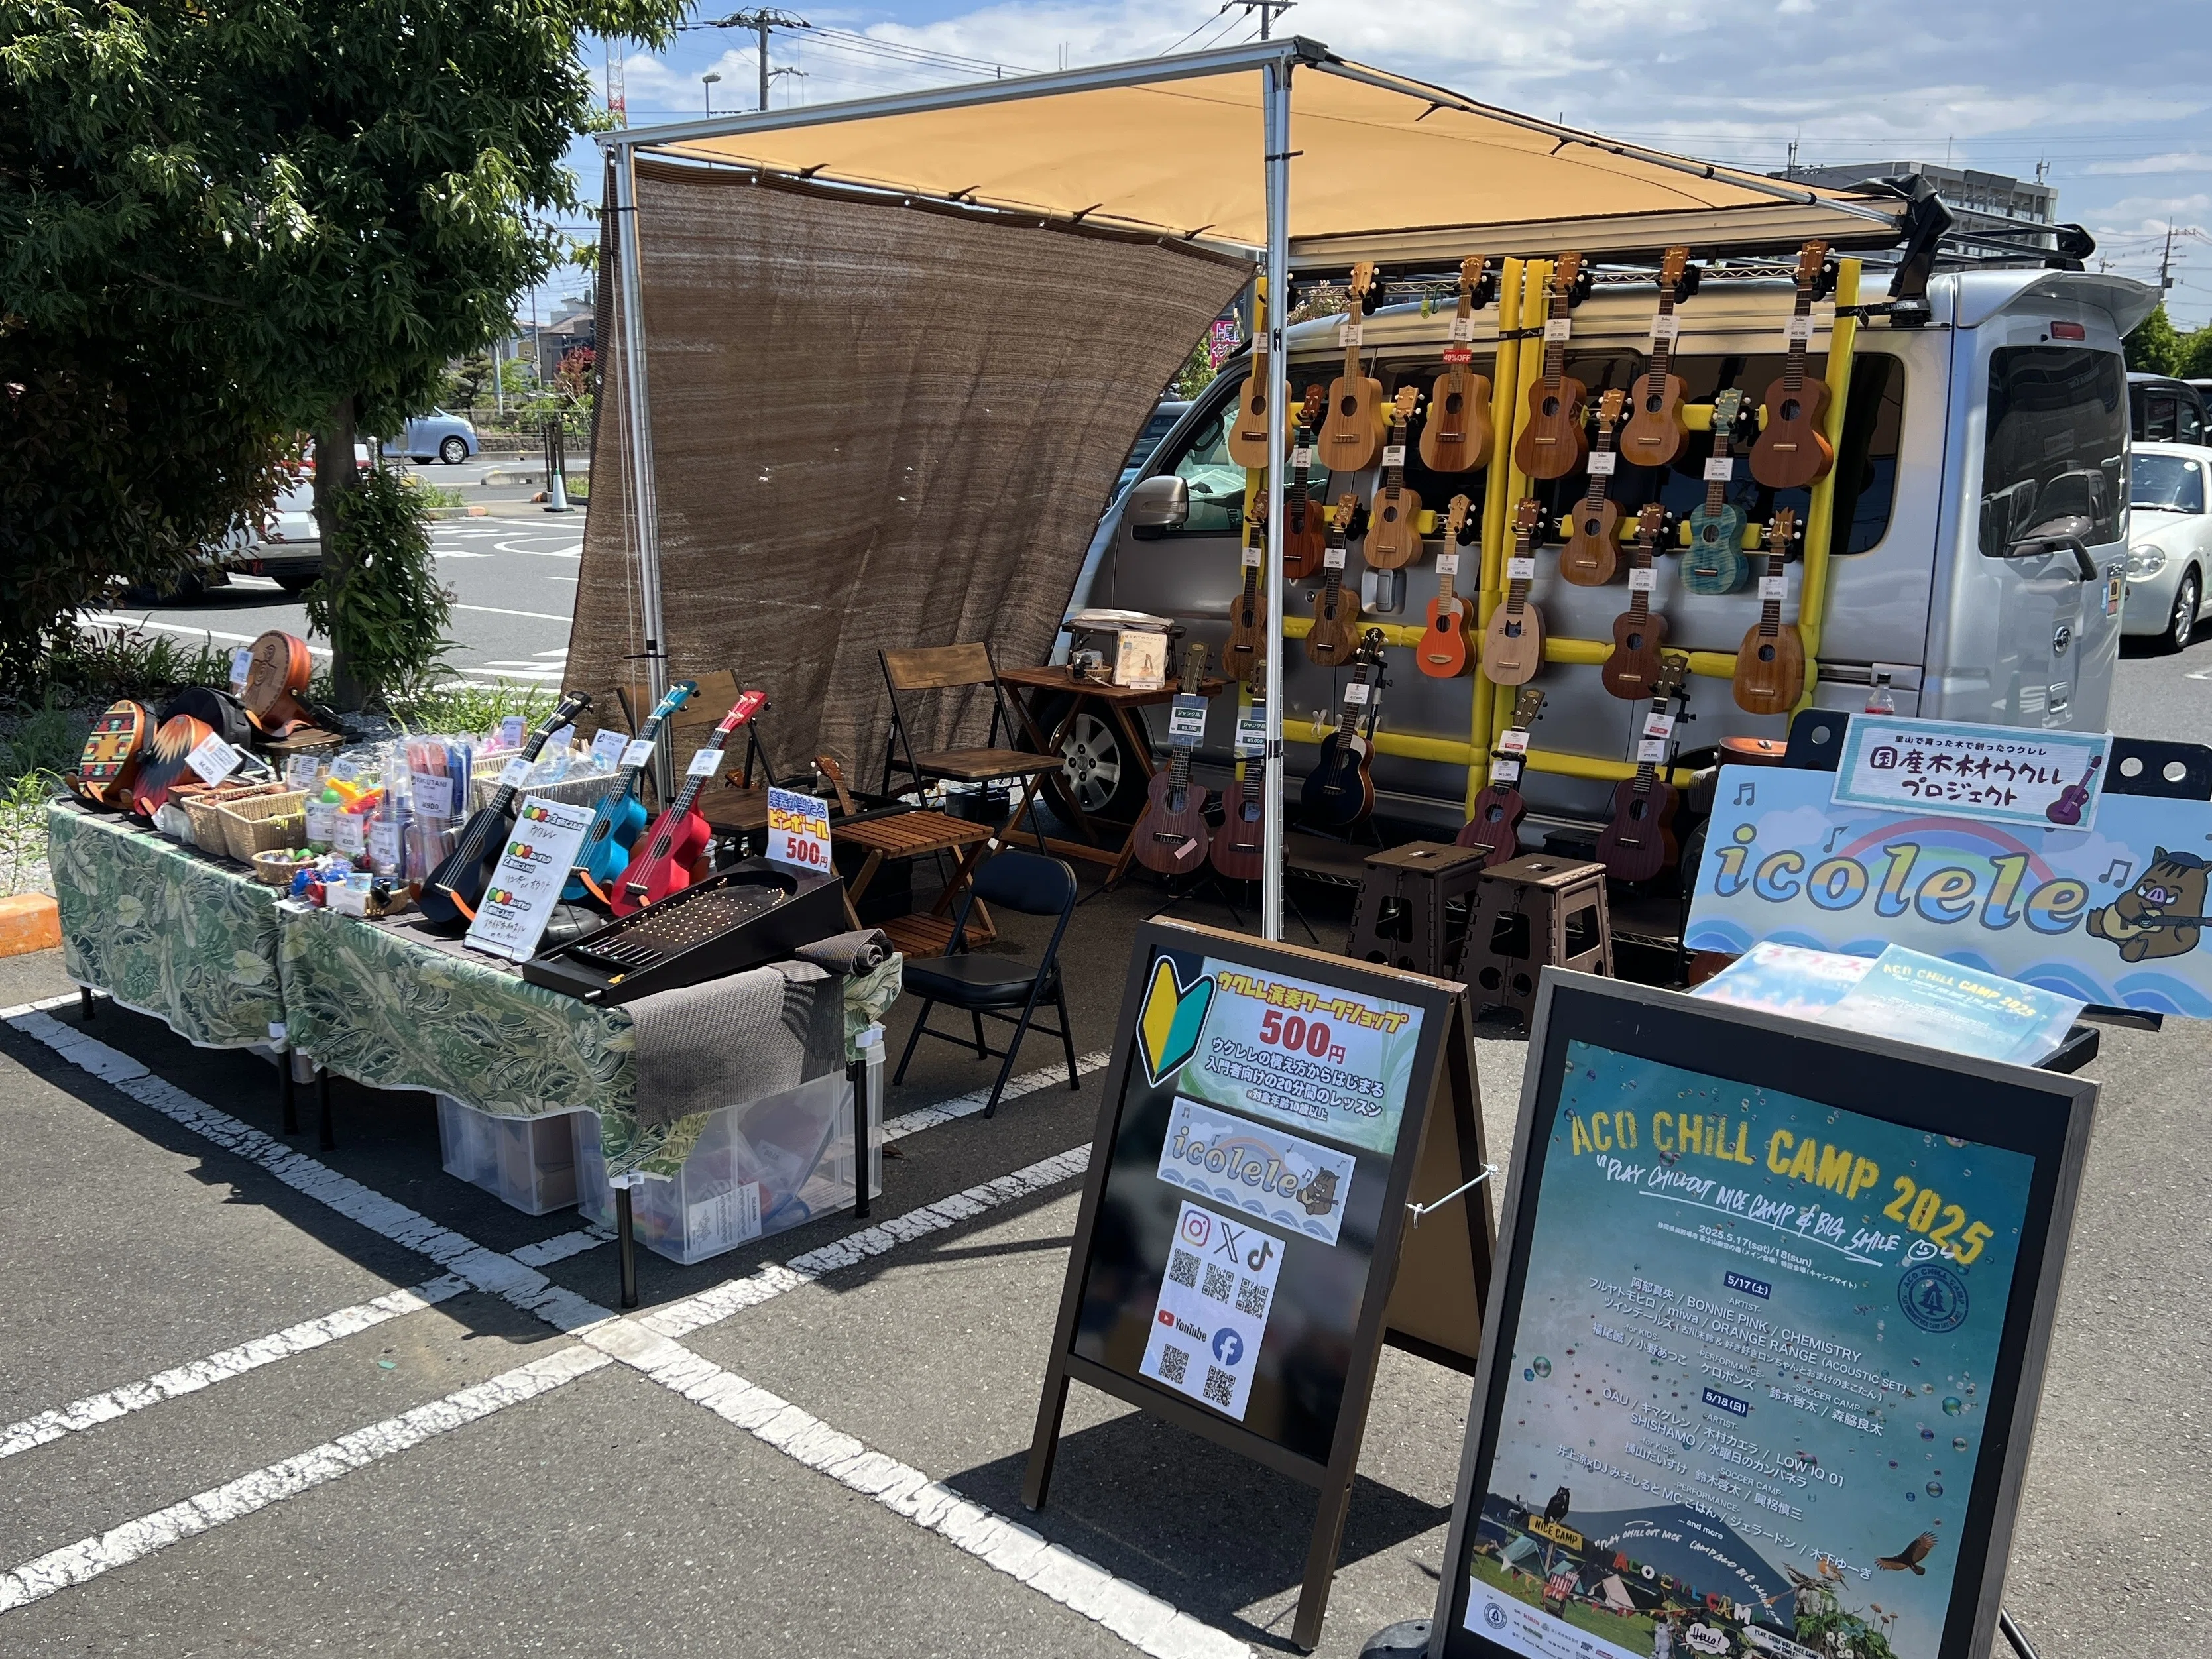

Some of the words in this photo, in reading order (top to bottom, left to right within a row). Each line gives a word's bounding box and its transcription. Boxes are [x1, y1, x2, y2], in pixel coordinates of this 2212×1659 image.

[1444, 353, 1471, 362] 40%OFF
[1177, 709, 1201, 718] ジャンク品
[416, 777, 447, 787] KIKUTANI
[1869, 746, 2064, 785] 国産木材ウクレレ
[769, 790, 826, 819] 楽器が当たる
[1901, 776, 2018, 807] プロジェクト
[768, 807, 829, 841] ピンボール
[786, 836, 828, 868] 500円
[1714, 823, 2090, 935] icolele
[1217, 970, 1410, 1034] ウクレレ演奏ワークショップ
[1958, 980, 2001, 1000] CAMP
[1999, 996, 2037, 1017] 2025
[1259, 1008, 1346, 1065] 500円
[1211, 1037, 1385, 1098] ウクレレの構え方からはじまる
[1204, 1055, 1383, 1117] 入門者向けの20分間のレッスン
[1172, 1125, 1299, 1198] icolele
[1572, 1110, 1638, 1156] ACO
[1766, 1129, 1880, 1200] CAMP
[1883, 1175, 1994, 1265] 2025
[1716, 1186, 1751, 1211] NICE
[1747, 1194, 1795, 1231] CAMP
[1813, 1211, 1847, 1243] BIG
[1844, 1228, 1901, 1254] SMILE
[1698, 1224, 1812, 1267] 2025.5.17(sat)/18(sun)
[1175, 1316, 1208, 1343] YouTube
[1604, 1296, 1674, 1331] ツインテールズ
[1631, 1277, 1676, 1302] 阿部真央
[1687, 1295, 1735, 1322] BONNIE
[1737, 1313, 1769, 1334] PINK
[1781, 1328, 1862, 1363] CHEMISTRY
[1590, 1277, 1656, 1309] フルヤトモヒロ
[1667, 1305, 1699, 1324] miwa
[1712, 1320, 1767, 1348] ORANGE
[1769, 1339, 1818, 1365] RANGE
[1822, 1357, 1880, 1385] (ACOUSTIC
[1882, 1377, 1907, 1395] SET)
[1592, 1322, 1625, 1344] 福尾誠
[1635, 1339, 1688, 1366] 小野あつこ
[1696, 1349, 1765, 1378] -PERFORMANCE-
[1700, 1362, 1757, 1391] ケロポンズ
[1769, 1386, 1819, 1414] 鈴木啓太
[1831, 1408, 1884, 1437] 森脇良太
[1792, 1384, 1832, 1403] -SOCCER
[1833, 1397, 1863, 1413] CAMP-
[1603, 1387, 1630, 1406] OAU
[1641, 1402, 1691, 1428] キマグレン
[1703, 1426, 1759, 1455] 木村カエラ
[1776, 1452, 1808, 1473] LOW
[1810, 1465, 1826, 1481] IQ
[1828, 1473, 1845, 1487] 01
[1630, 1412, 1696, 1446] SHISHAMO
[1708, 1443, 1808, 1489] 水曜日のカンパネラ
[1625, 1440, 1688, 1475] 横山だいすけ
[1674, 1481, 1741, 1513] -PERFORMANCE-
[1694, 1469, 1742, 1498] 鈴木啓太
[1717, 1466, 1755, 1487] -SOCCER
[1756, 1481, 1785, 1497] CAMP-
[1535, 1519, 1554, 1538] NICE
[1555, 1528, 1578, 1546] CAMP
[1609, 1466, 1660, 1495] みそしると
[1662, 1487, 1683, 1504] MC
[1684, 1496, 1717, 1519] ごはん
[1729, 1515, 1796, 1548] ジェラードン
[1810, 1547, 1873, 1581] 木下ゆーき
[1686, 1519, 1702, 1531] and
[1702, 1527, 1723, 1540] more
[1613, 1552, 1655, 1580] ACO
